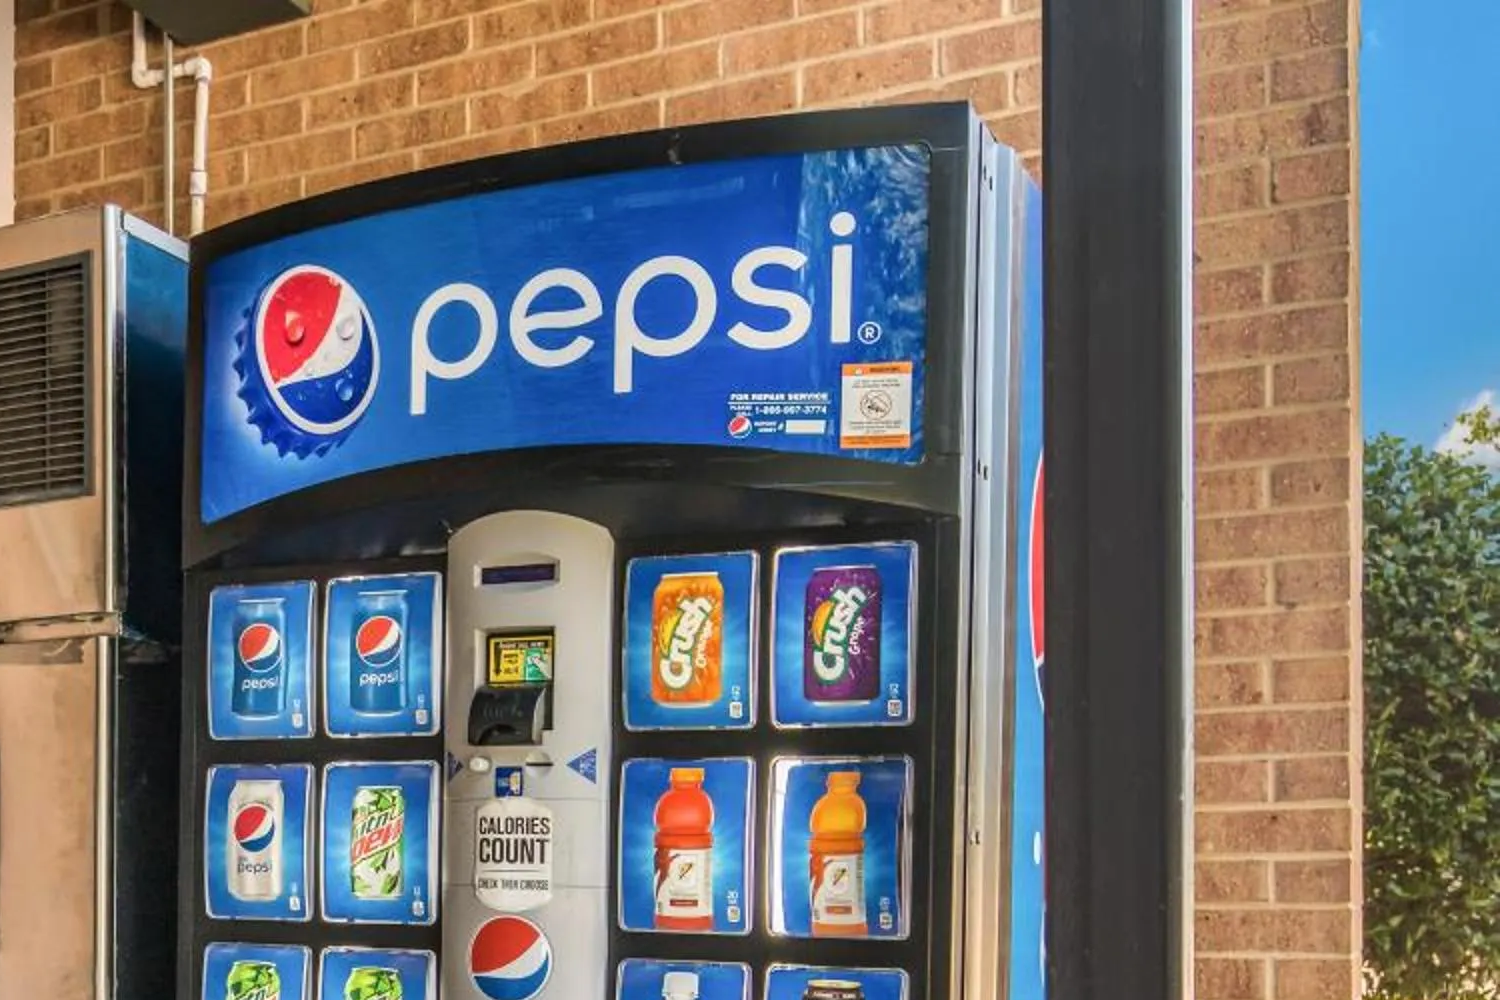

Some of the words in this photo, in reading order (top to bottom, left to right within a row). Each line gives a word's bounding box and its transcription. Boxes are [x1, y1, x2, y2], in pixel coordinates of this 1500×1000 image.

[410, 211, 857, 415] pepsi
[241, 676, 279, 692] pepsi
[359, 671, 399, 688] pepsi
[479, 816, 551, 835] CALORIES
[479, 837, 550, 865] COUNT
